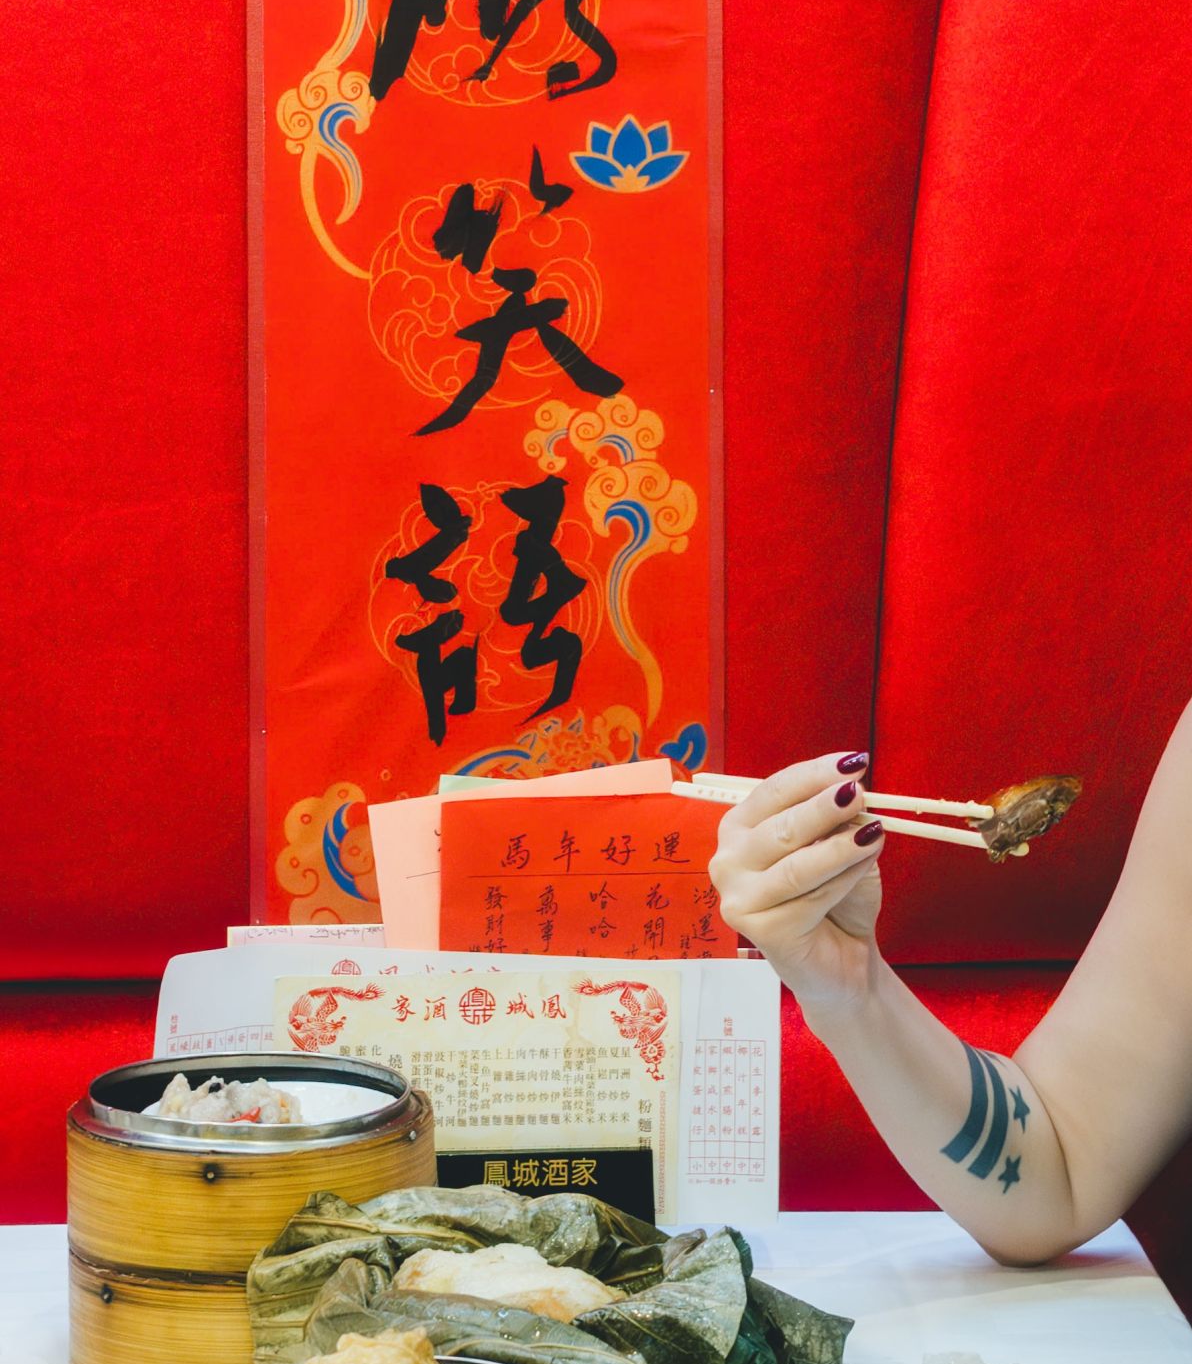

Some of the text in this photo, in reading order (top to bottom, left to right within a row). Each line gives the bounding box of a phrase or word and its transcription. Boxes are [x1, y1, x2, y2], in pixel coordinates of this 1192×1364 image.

[501, 830, 690, 873] 馬年好運
[643, 882, 670, 957] 花開
[482, 1157, 598, 1188] 鳳城酒家
